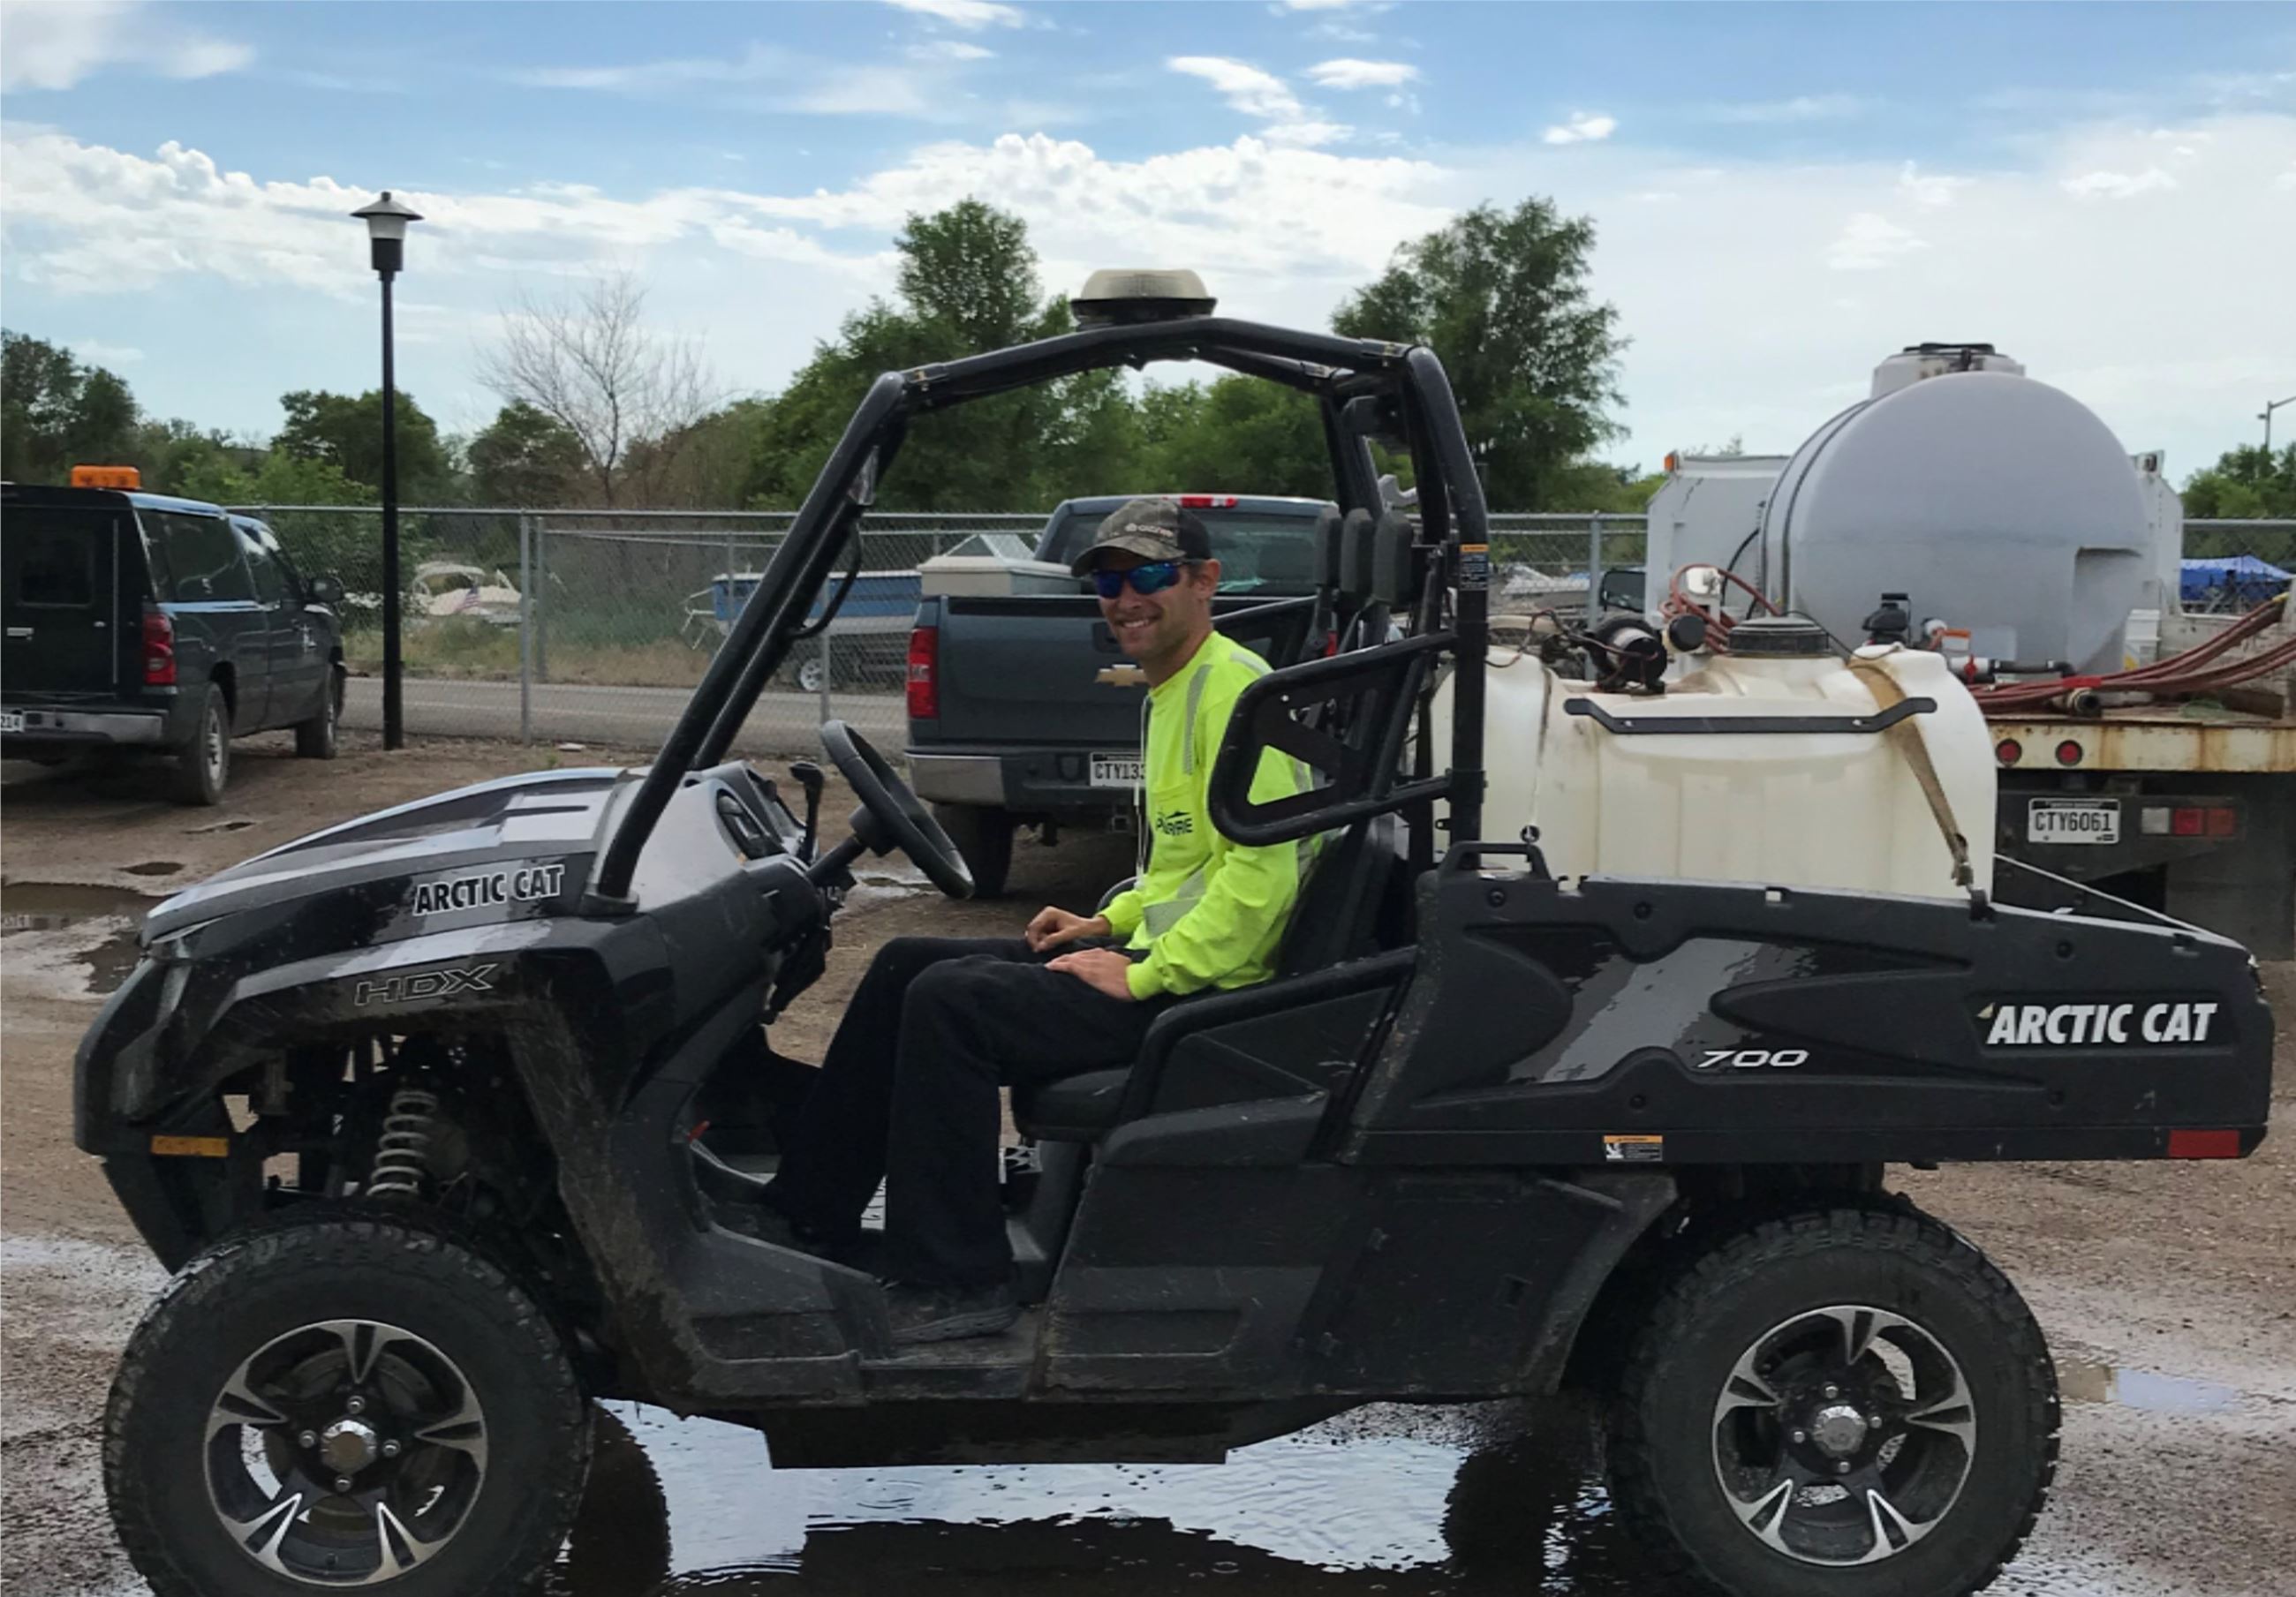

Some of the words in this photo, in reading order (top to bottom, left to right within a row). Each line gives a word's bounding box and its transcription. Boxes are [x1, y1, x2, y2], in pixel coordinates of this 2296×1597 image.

[2035, 812, 2112, 832] CTY6061
[412, 871, 507, 916] ARCTIC
[513, 864, 565, 900] CAT
[354, 963, 499, 1006] HDX
[1986, 1004, 2134, 1044] ARCTIC
[2141, 1002, 2217, 1043] CAT
[1697, 1049, 1809, 1068] 700
